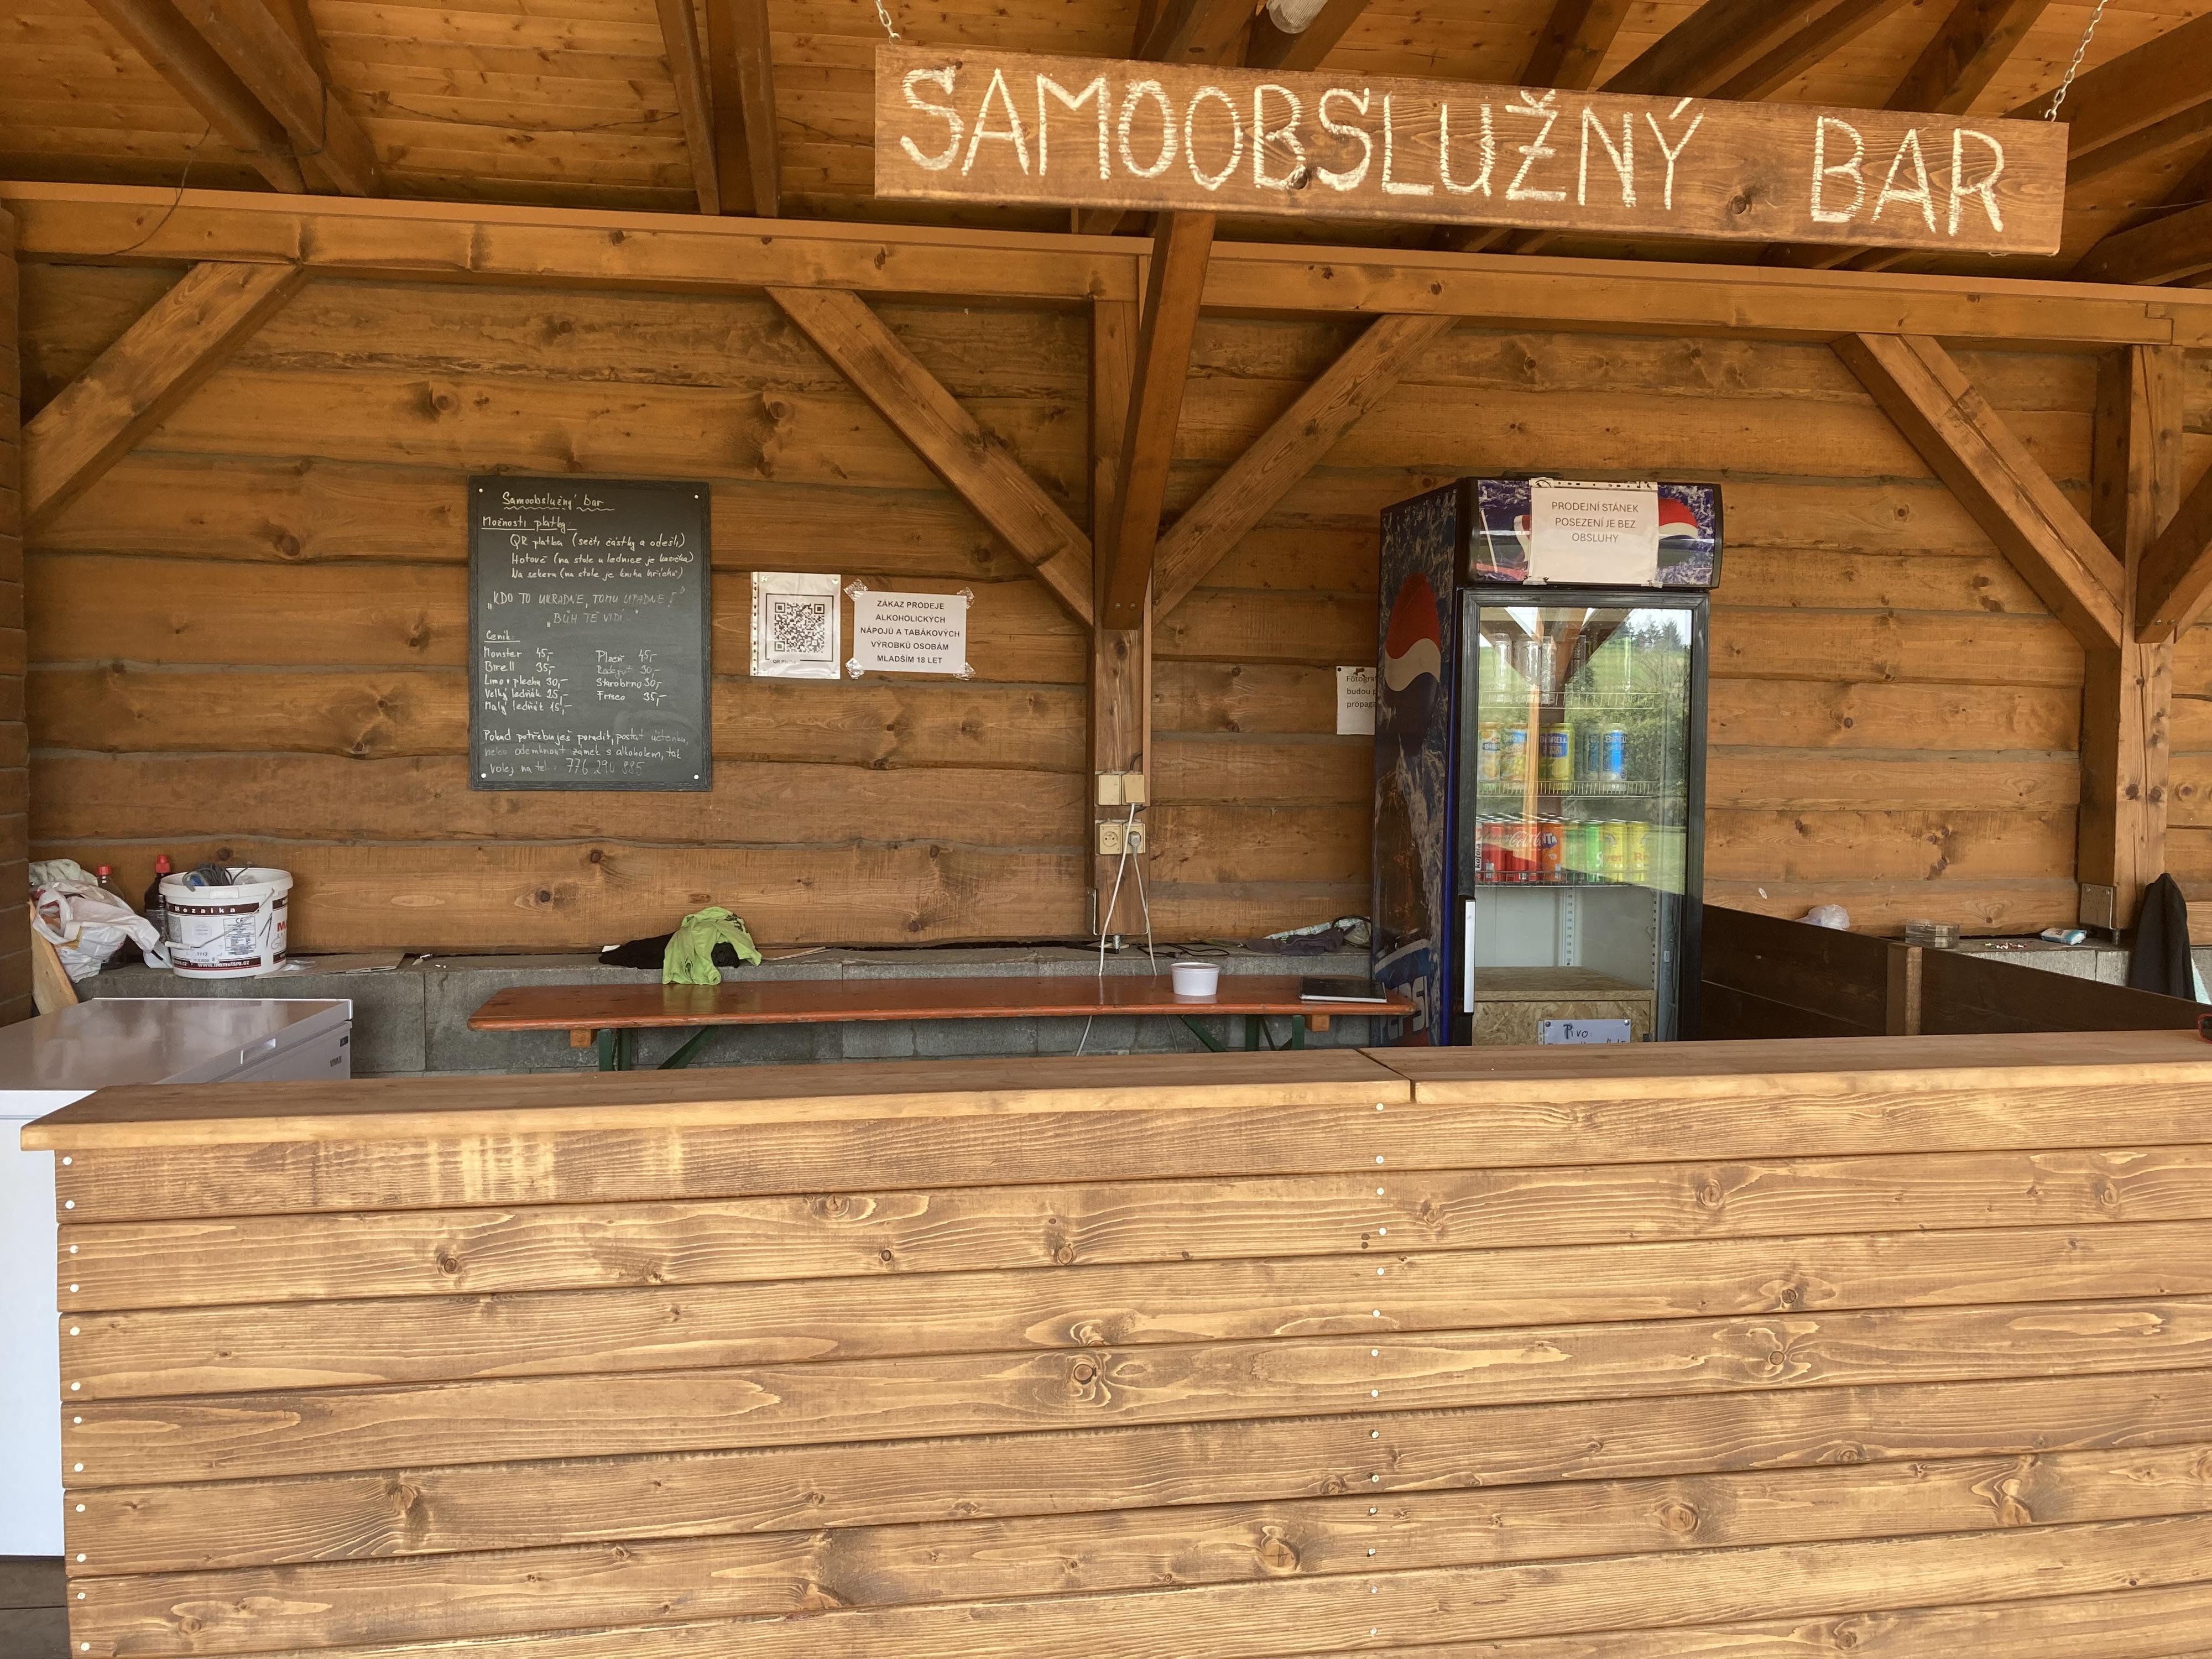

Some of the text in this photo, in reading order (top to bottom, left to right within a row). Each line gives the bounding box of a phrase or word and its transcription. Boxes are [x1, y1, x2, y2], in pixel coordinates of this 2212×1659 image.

[901, 67, 2004, 236] SAMOOBSLUŽNÝ BAR
[502, 492, 604, 510] Samoobslužný bar
[1552, 501, 1639, 513] PRODEJNÍ STÁNEK
[483, 515, 526, 528] Možnosti
[1555, 517, 1636, 528] POSEZENÍ JE BEZ
[510, 534, 529, 550] QR
[532, 535, 564, 550] platba
[1572, 533, 1619, 542] OBSLUHY
[554, 552, 569, 565] (na
[573, 553, 595, 564] stole
[607, 553, 643, 563] lednice
[645, 556, 655, 567] je
[512, 567, 523, 579] Na
[560, 567, 575, 579] (na
[578, 567, 600, 578] stole
[601, 571, 614, 582] je
[619, 568, 643, 578] kniha
[518, 592, 531, 604] TO
[593, 594, 619, 604] TOMU
[877, 599, 945, 609] ZÁKAZ PRODEJE
[875, 613, 945, 623] ALKOHOLICKÝCH
[860, 626, 894, 635] NÁPOJŮ
[904, 628, 960, 637] TABÁKOVÝCH
[871, 640, 949, 650] VÝROBKŮ OSOBÁM
[483, 646, 523, 658] Monster
[595, 649, 625, 663] Plzeň
[877, 654, 914, 663] MLADŠÍM
[484, 660, 515, 672] Birell
[484, 674, 504, 685] Limo
[513, 675, 541, 688] plechu
[596, 677, 643, 688] Starobrno
[1346, 675, 1376, 684] Fotogra
[485, 687, 508, 701] Velký
[596, 690, 626, 702] Frisco
[485, 700, 507, 716] Malý
[666, 747, 682, 759] tak
[521, 765, 533, 774] na
[566, 758, 588, 775] 776
